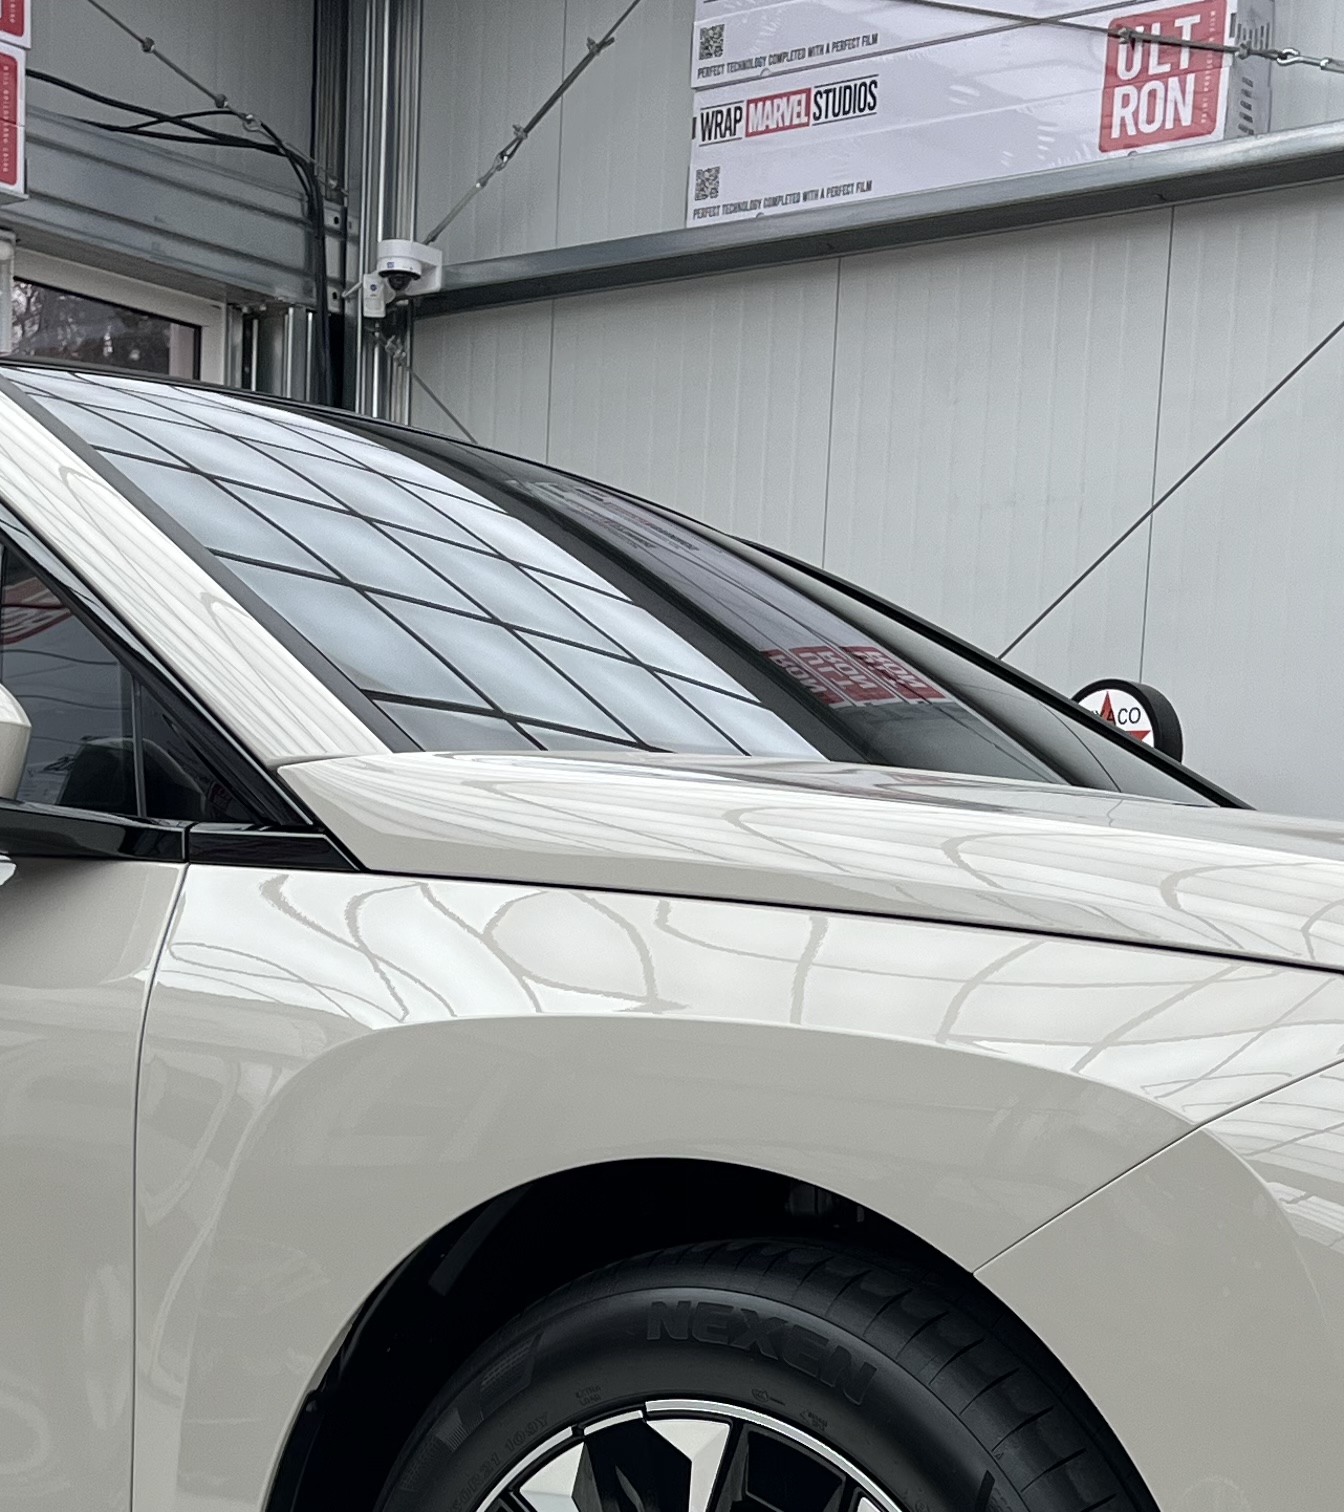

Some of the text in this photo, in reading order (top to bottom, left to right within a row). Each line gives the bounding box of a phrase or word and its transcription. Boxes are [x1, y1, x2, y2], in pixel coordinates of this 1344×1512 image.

[697, 33, 879, 80] PERFECT TECHNOLOGY COMPLETED WITH A PERFECT FILM
[1117, 14, 1201, 80] ULT
[699, 105, 744, 143] WRAP
[747, 93, 809, 134] MARVEL
[812, 79, 879, 122] STUDIOS
[1111, 73, 1196, 139] RON
[692, 179, 873, 221] PERFECT TECHNOLOGY COMPLETED WITH A PERFECT FILM
[646, 1300, 878, 1407] NEXEN
